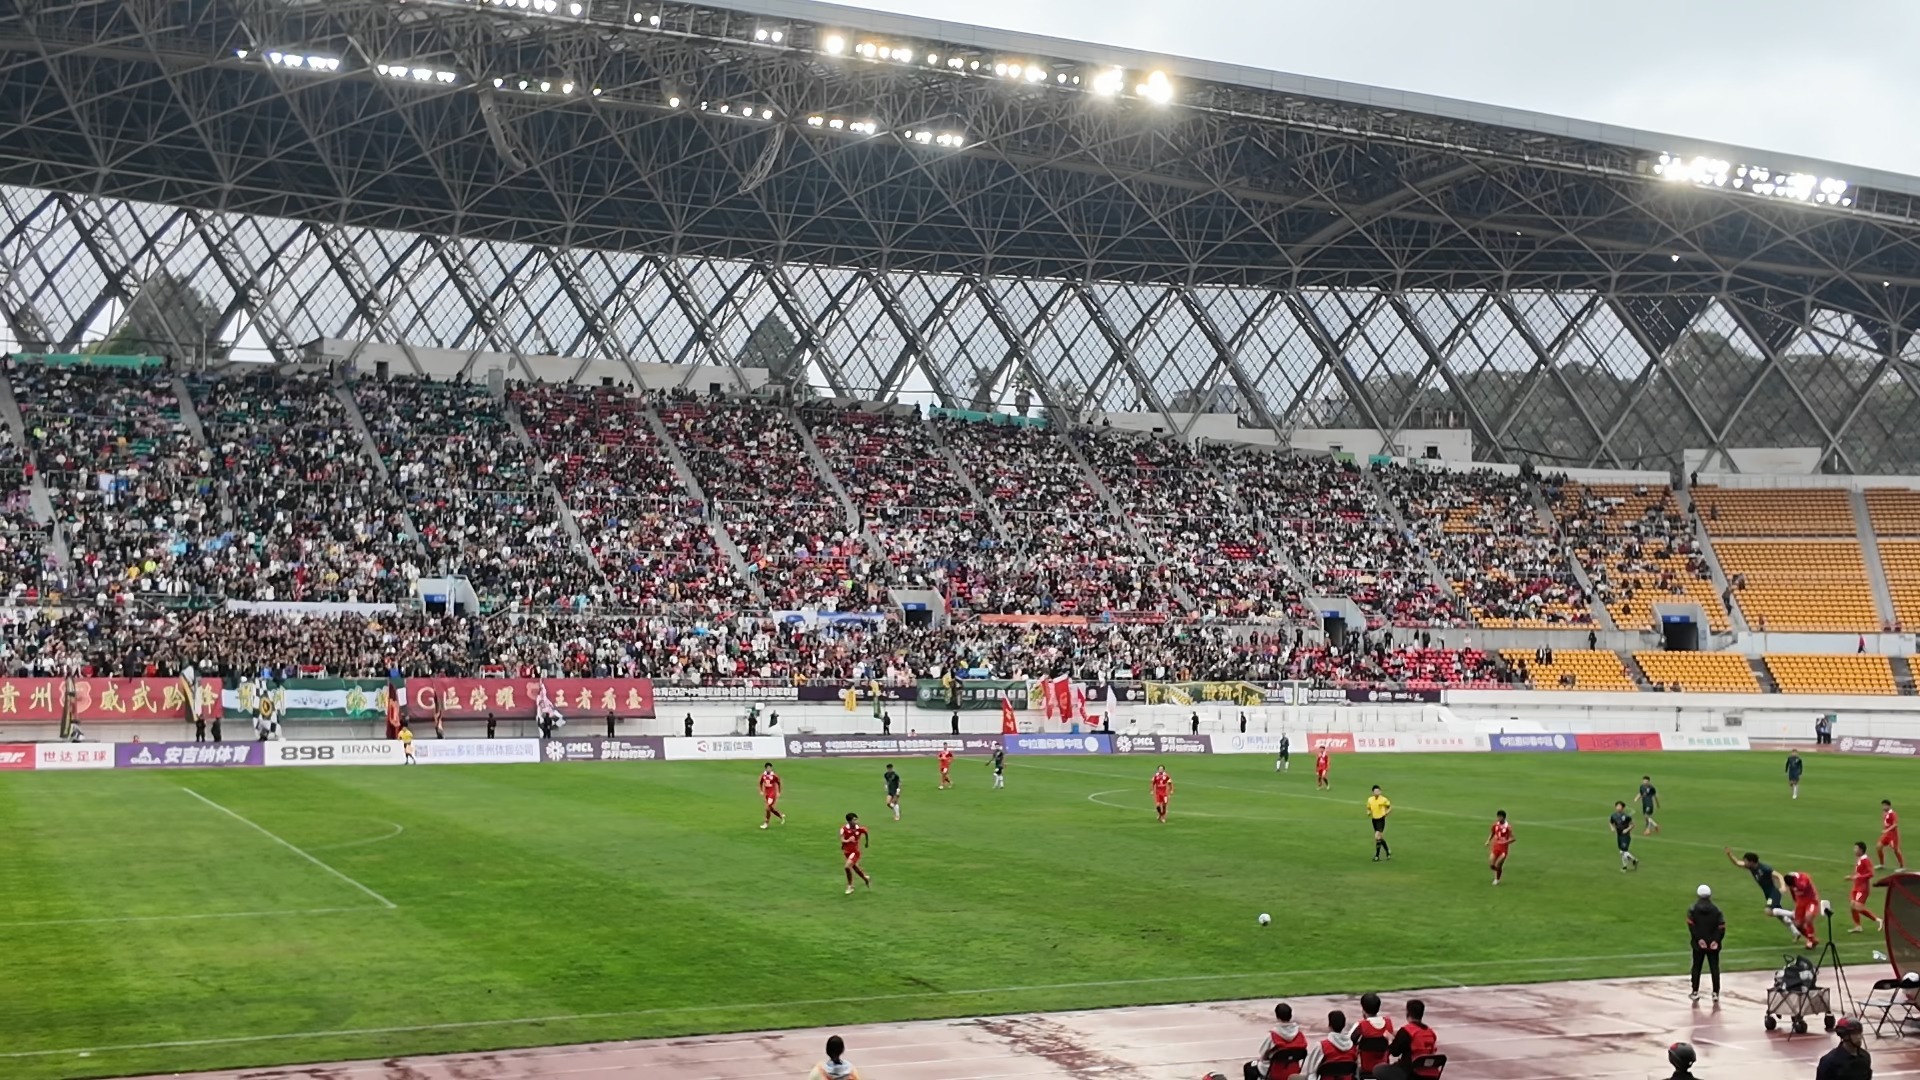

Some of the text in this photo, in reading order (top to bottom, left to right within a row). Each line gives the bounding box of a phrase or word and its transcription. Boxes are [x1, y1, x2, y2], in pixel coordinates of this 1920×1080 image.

[566, 742, 594, 753] CMCL
[1132, 737, 1155, 746] CMCL
[44, 750, 107, 762] 世达足球
[163, 745, 251, 764] 安吉纳体育
[280, 744, 392, 760] 898 BRAND
